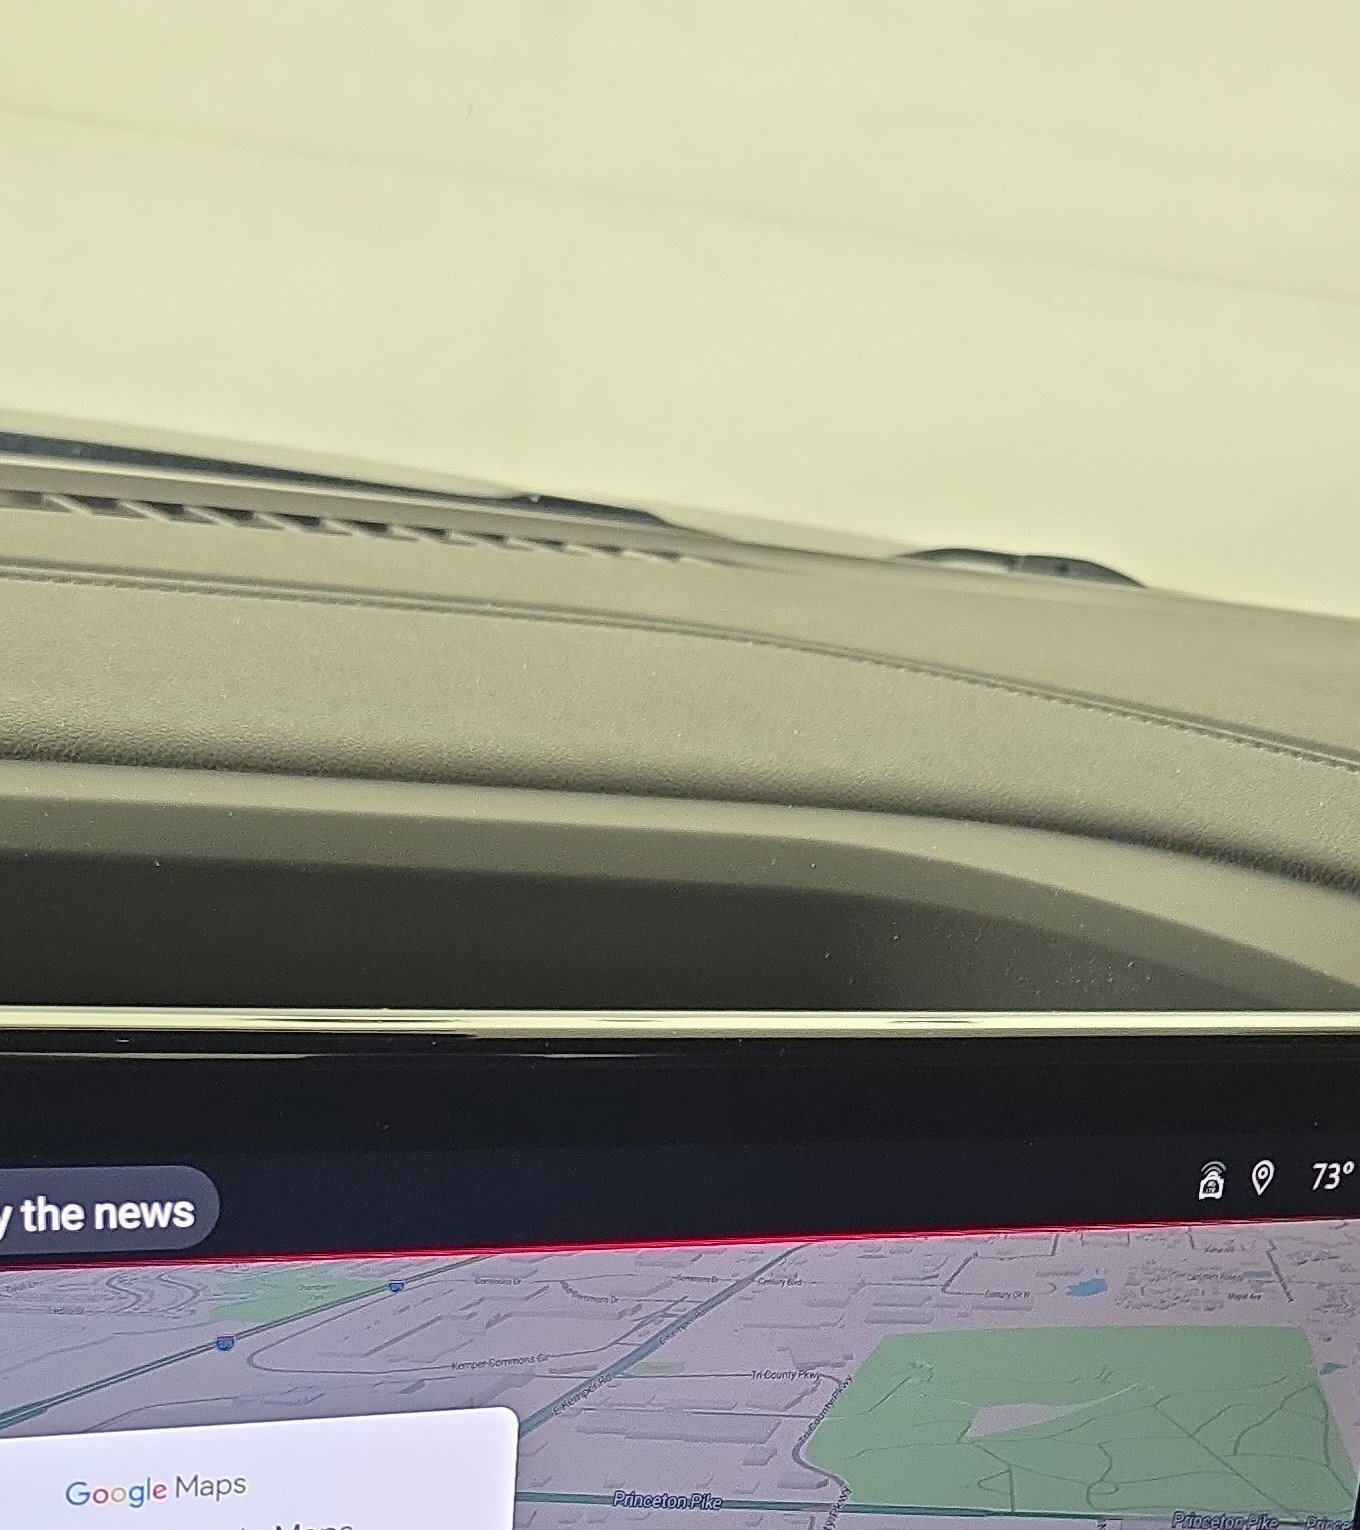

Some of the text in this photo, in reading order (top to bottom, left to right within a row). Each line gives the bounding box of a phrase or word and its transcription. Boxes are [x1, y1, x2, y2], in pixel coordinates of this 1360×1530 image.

[19, 1195, 84, 1232] the
[93, 1200, 196, 1230] news
[764, 1370, 797, 1381] County
[65, 1474, 247, 1508] Google Maps
[612, 1490, 723, 1510] Princeton Pike
[829, 1485, 852, 1518] Pkwy
[1171, 1511, 1244, 1530] Princeton
